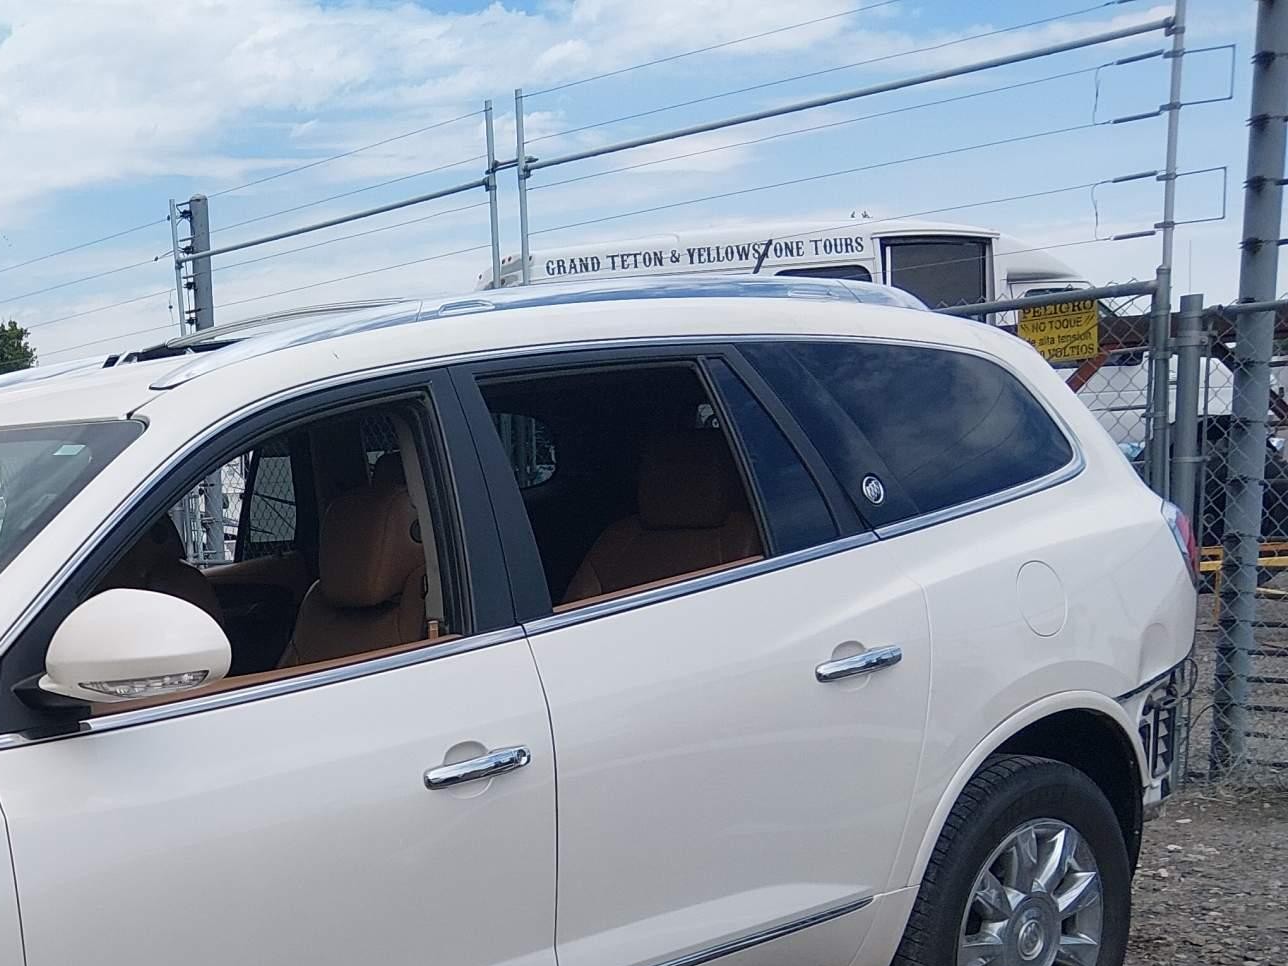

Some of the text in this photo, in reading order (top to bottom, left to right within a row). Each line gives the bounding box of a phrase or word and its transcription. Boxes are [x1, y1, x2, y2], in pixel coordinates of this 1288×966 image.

[545, 255, 601, 276] GRAND
[606, 250, 664, 271] TETON
[669, 249, 681, 264] &
[809, 236, 865, 256] TOURS
[1031, 316, 1083, 333] NO TOQUE
